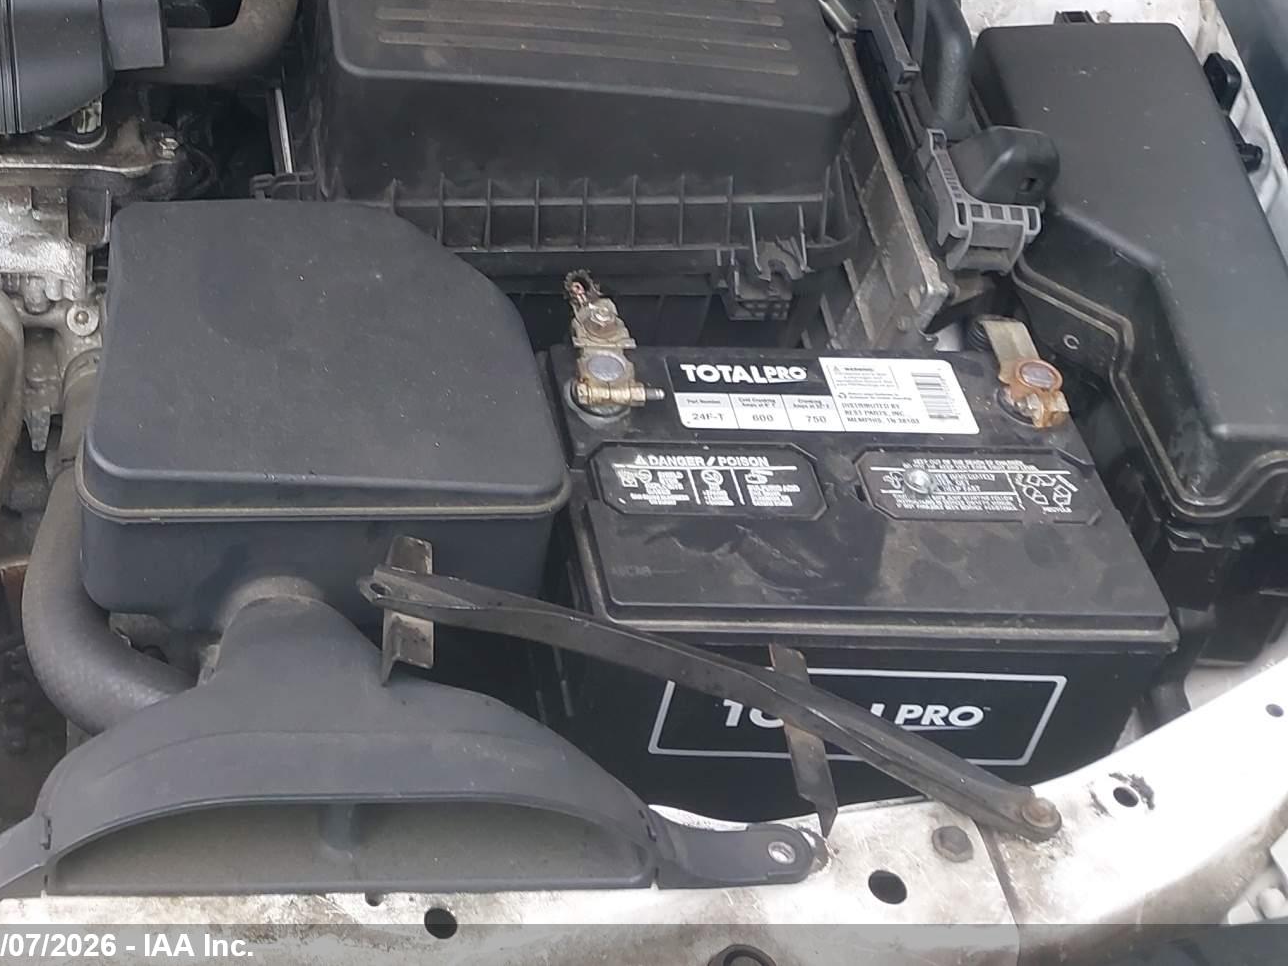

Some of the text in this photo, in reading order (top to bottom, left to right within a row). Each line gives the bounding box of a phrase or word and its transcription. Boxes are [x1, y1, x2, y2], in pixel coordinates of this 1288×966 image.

[679, 364, 808, 384] TOTALPRO
[752, 414, 774, 422] 600
[806, 415, 827, 423] 750
